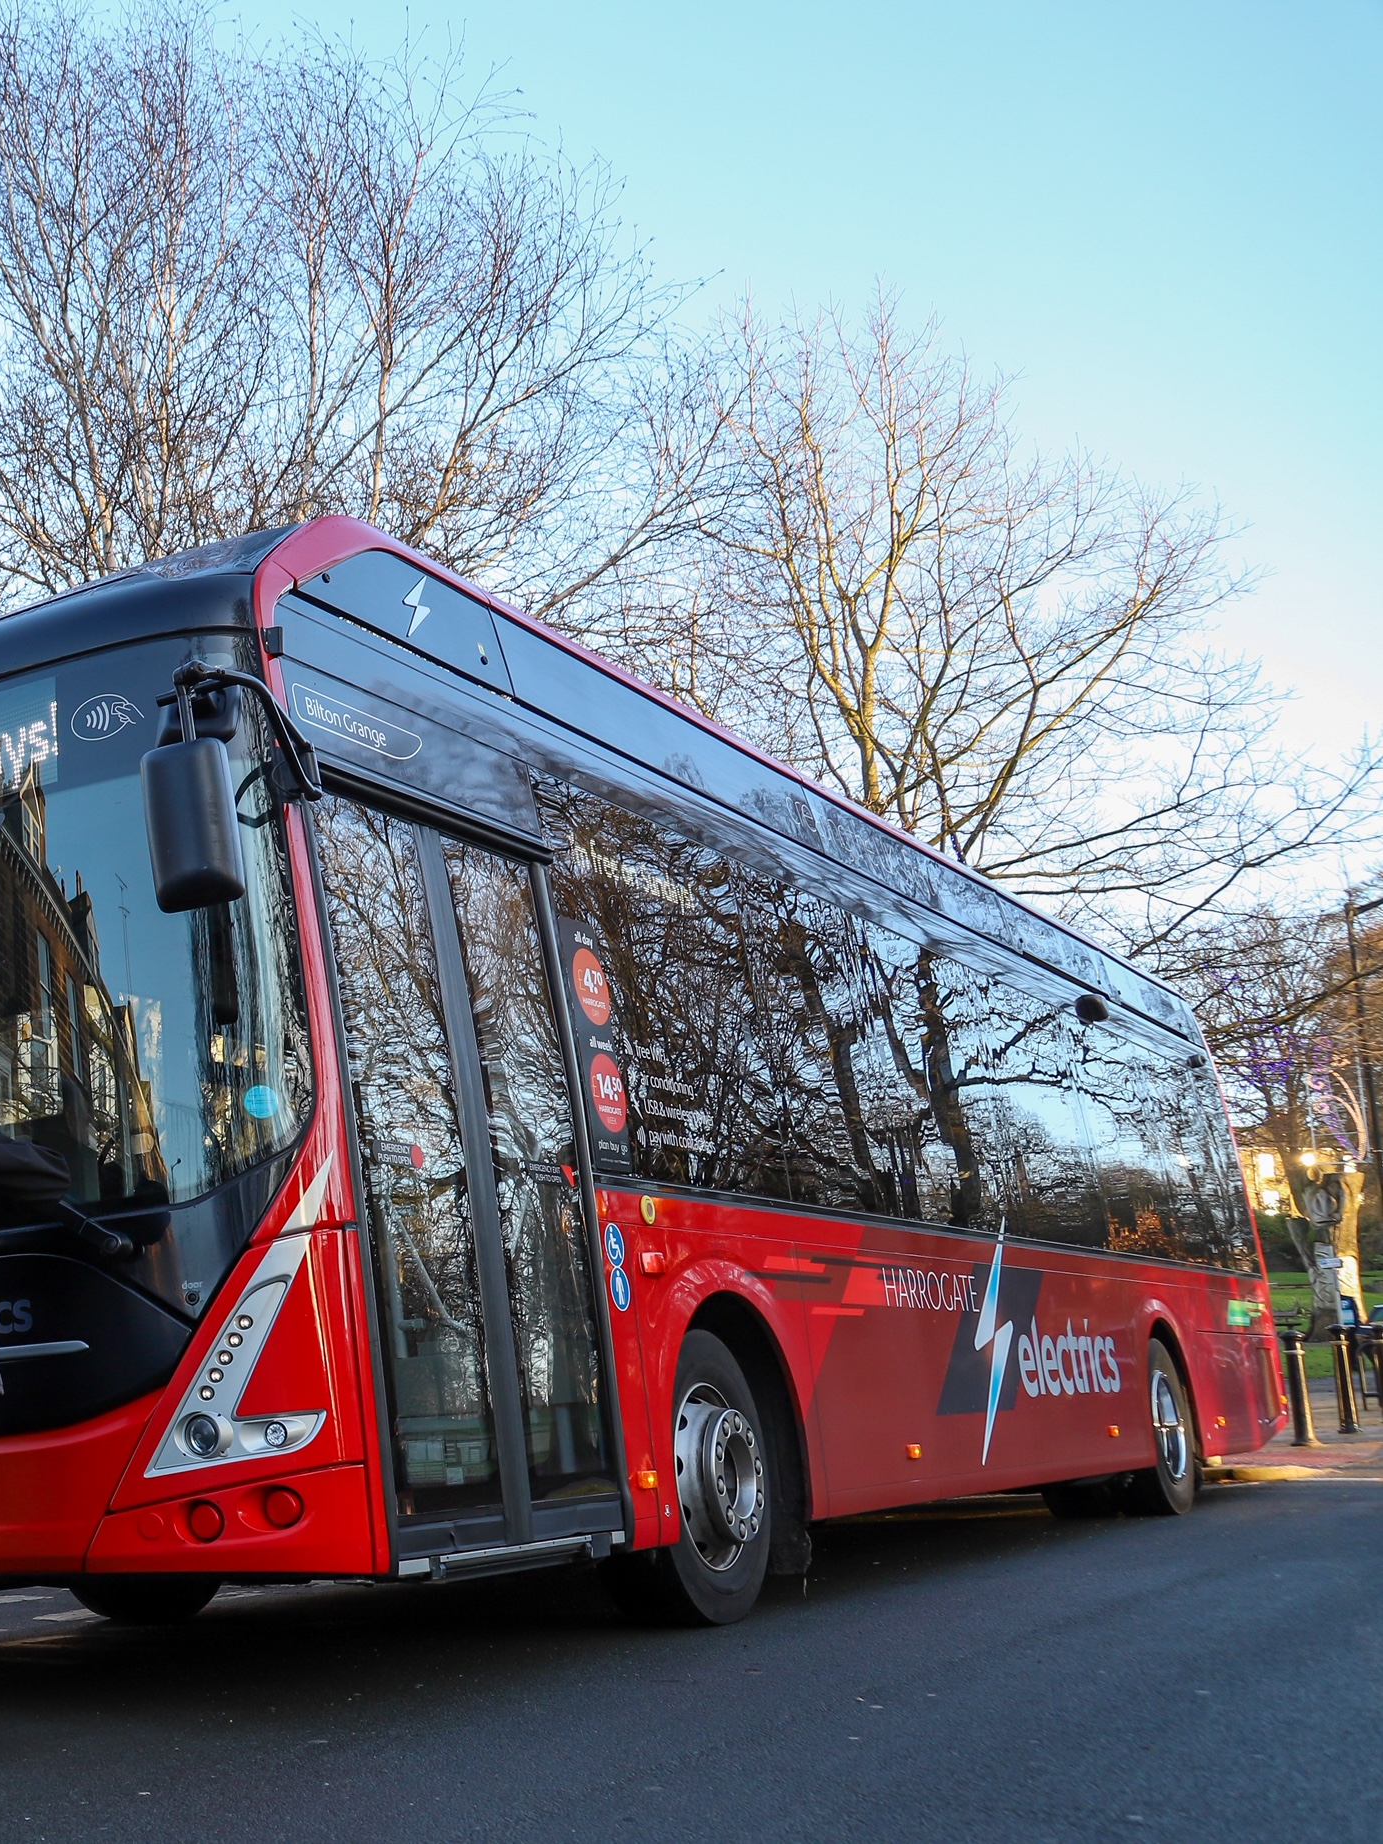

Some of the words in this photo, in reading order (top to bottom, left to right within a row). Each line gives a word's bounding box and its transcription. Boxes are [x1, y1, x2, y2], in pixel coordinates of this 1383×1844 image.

[305, 696, 342, 728] Bilton
[343, 714, 387, 748] Grange
[582, 933, 593, 949] day
[597, 1039, 613, 1052] week
[650, 1075, 695, 1100] conditioning
[598, 1104, 623, 1116] HARROGATE
[644, 1099, 659, 1115] USB
[598, 1139, 610, 1150] plan
[610, 1141, 619, 1154] buy
[662, 1131, 678, 1147] with
[381, 1142, 410, 1154] EMERGENCY
[377, 1152, 391, 1164] PUSH
[391, 1154, 397, 1164] TO
[397, 1155, 412, 1166] OPEN
[182, 1280, 203, 1290] door
[882, 1267, 980, 1312] HARROGATE
[1018, 1315, 1121, 1398] electrics
